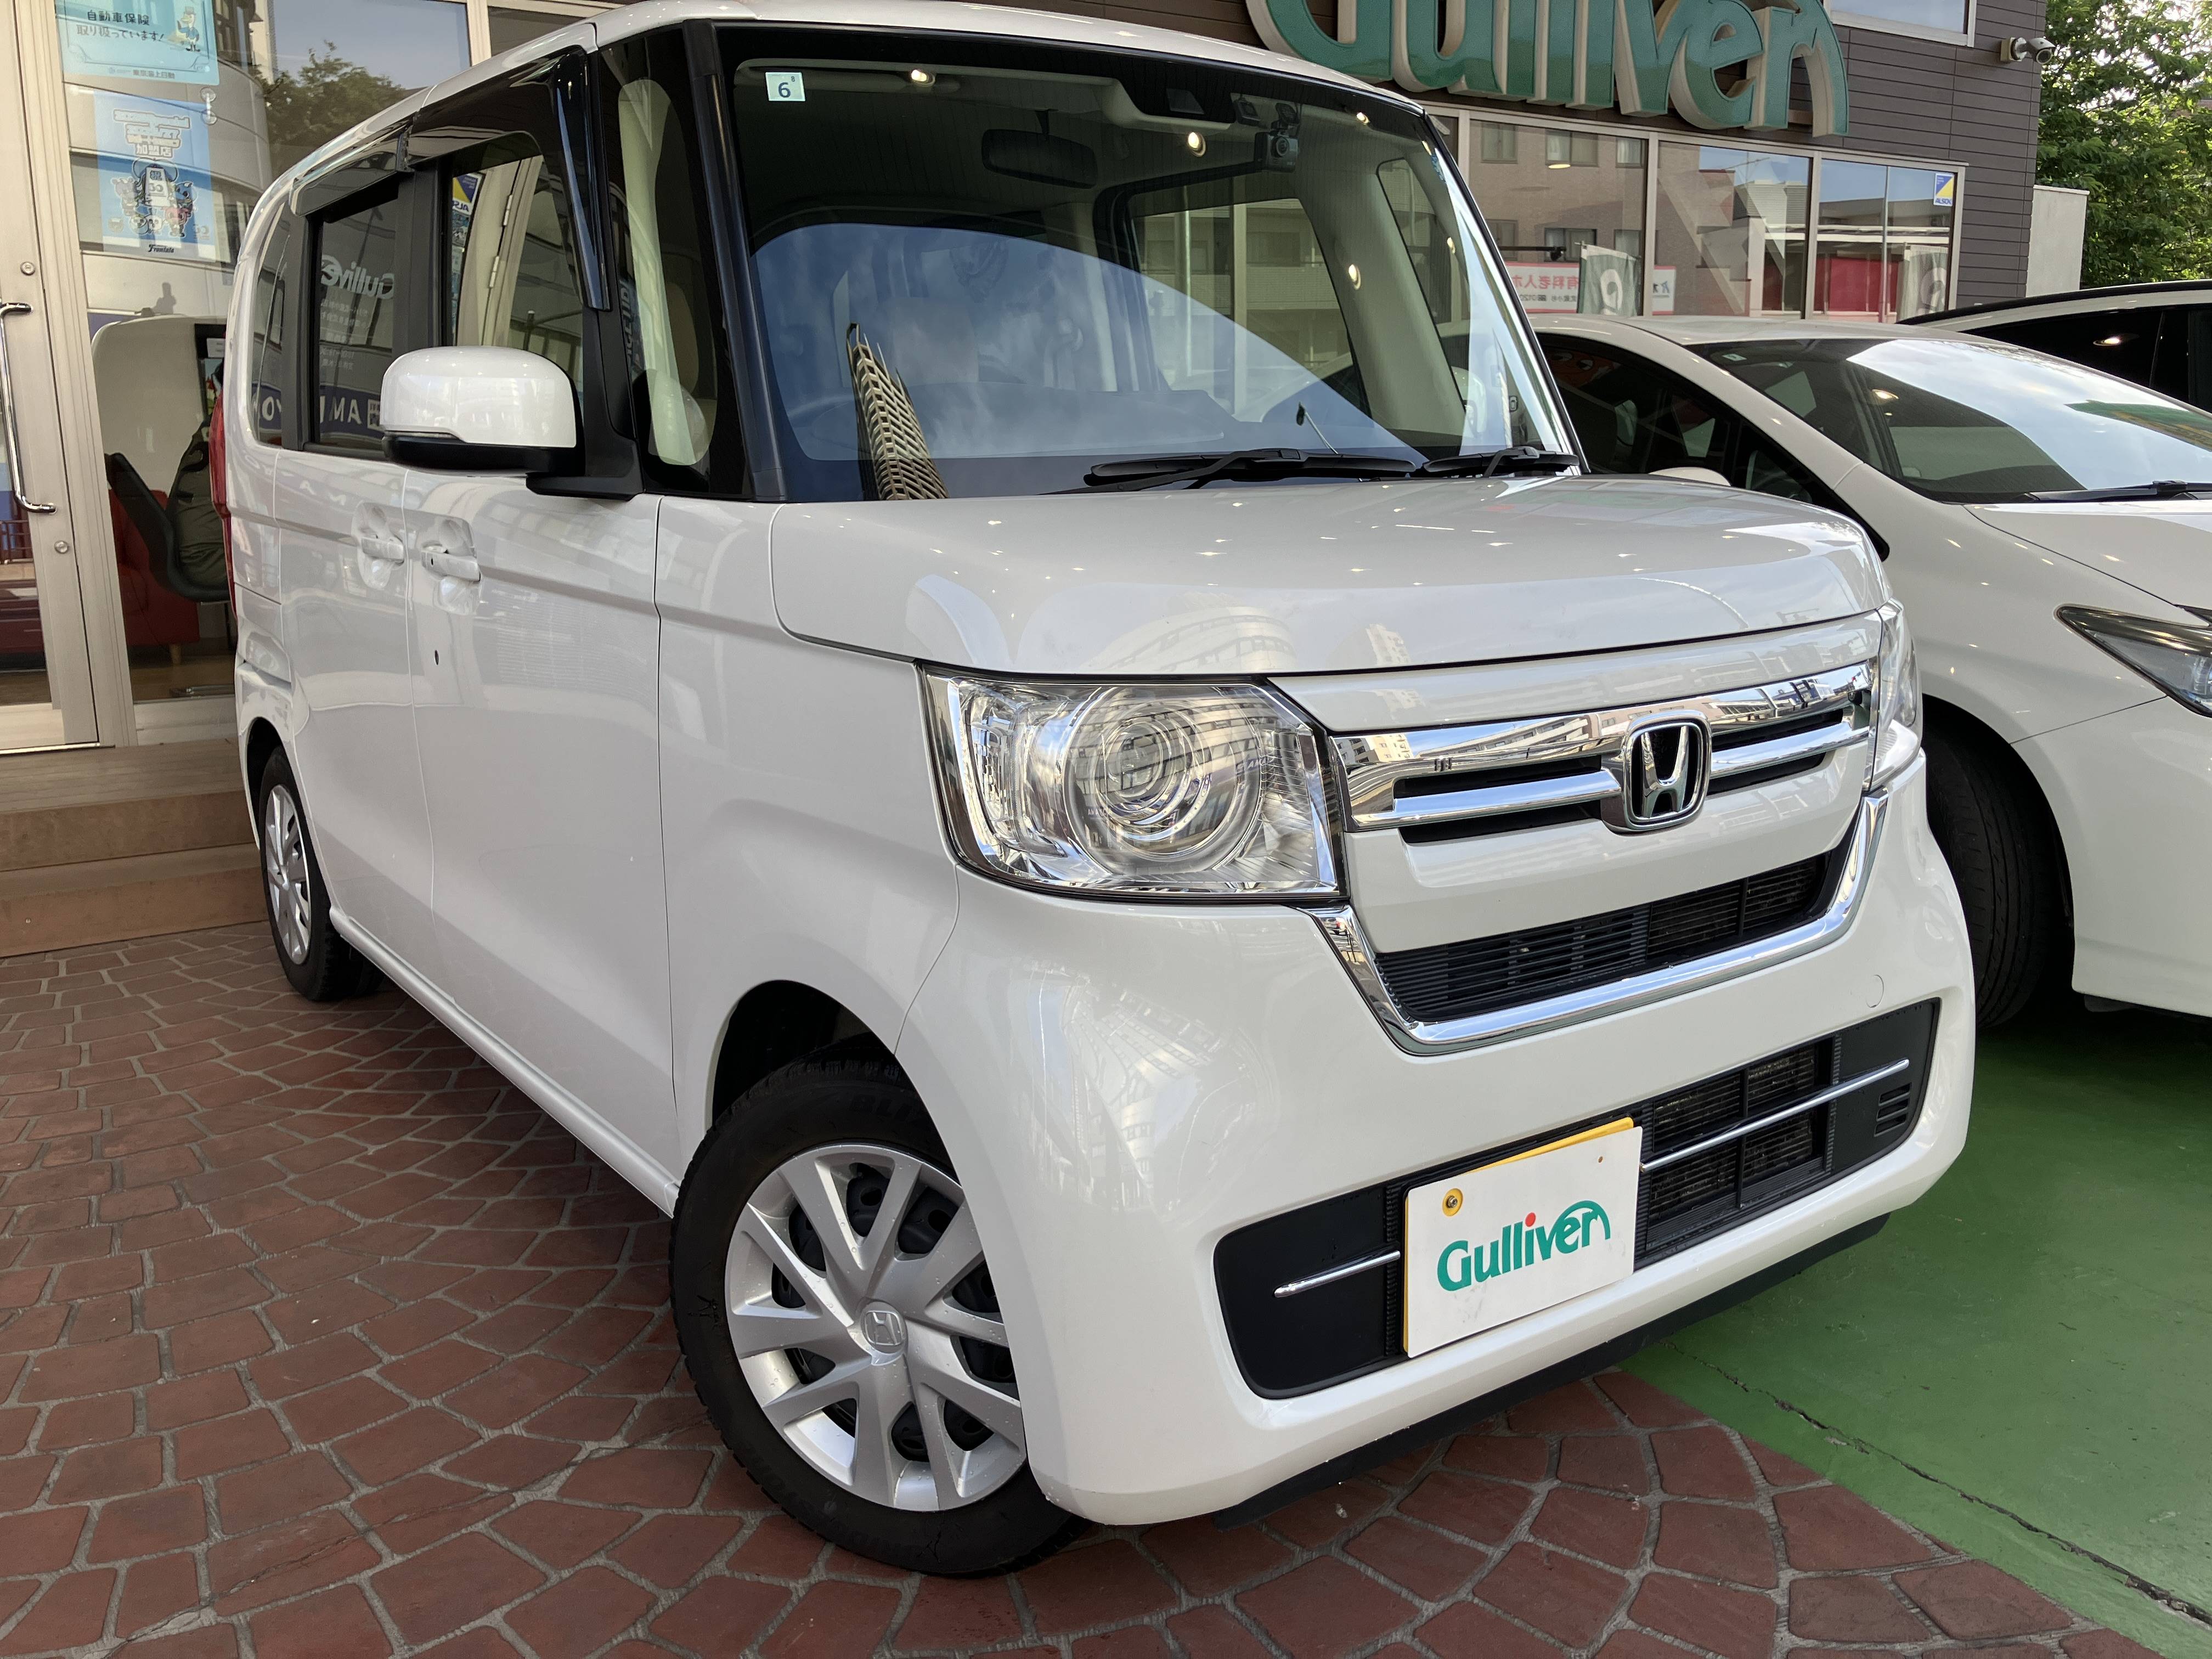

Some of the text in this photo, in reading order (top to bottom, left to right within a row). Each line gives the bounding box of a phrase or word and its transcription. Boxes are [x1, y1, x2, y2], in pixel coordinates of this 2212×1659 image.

[87, 10, 150, 26] 自動車保険
[778, 82, 791, 98] 6
[137, 144, 172, 157] 加盟店
[1437, 1200, 1611, 1292] Gulliver
